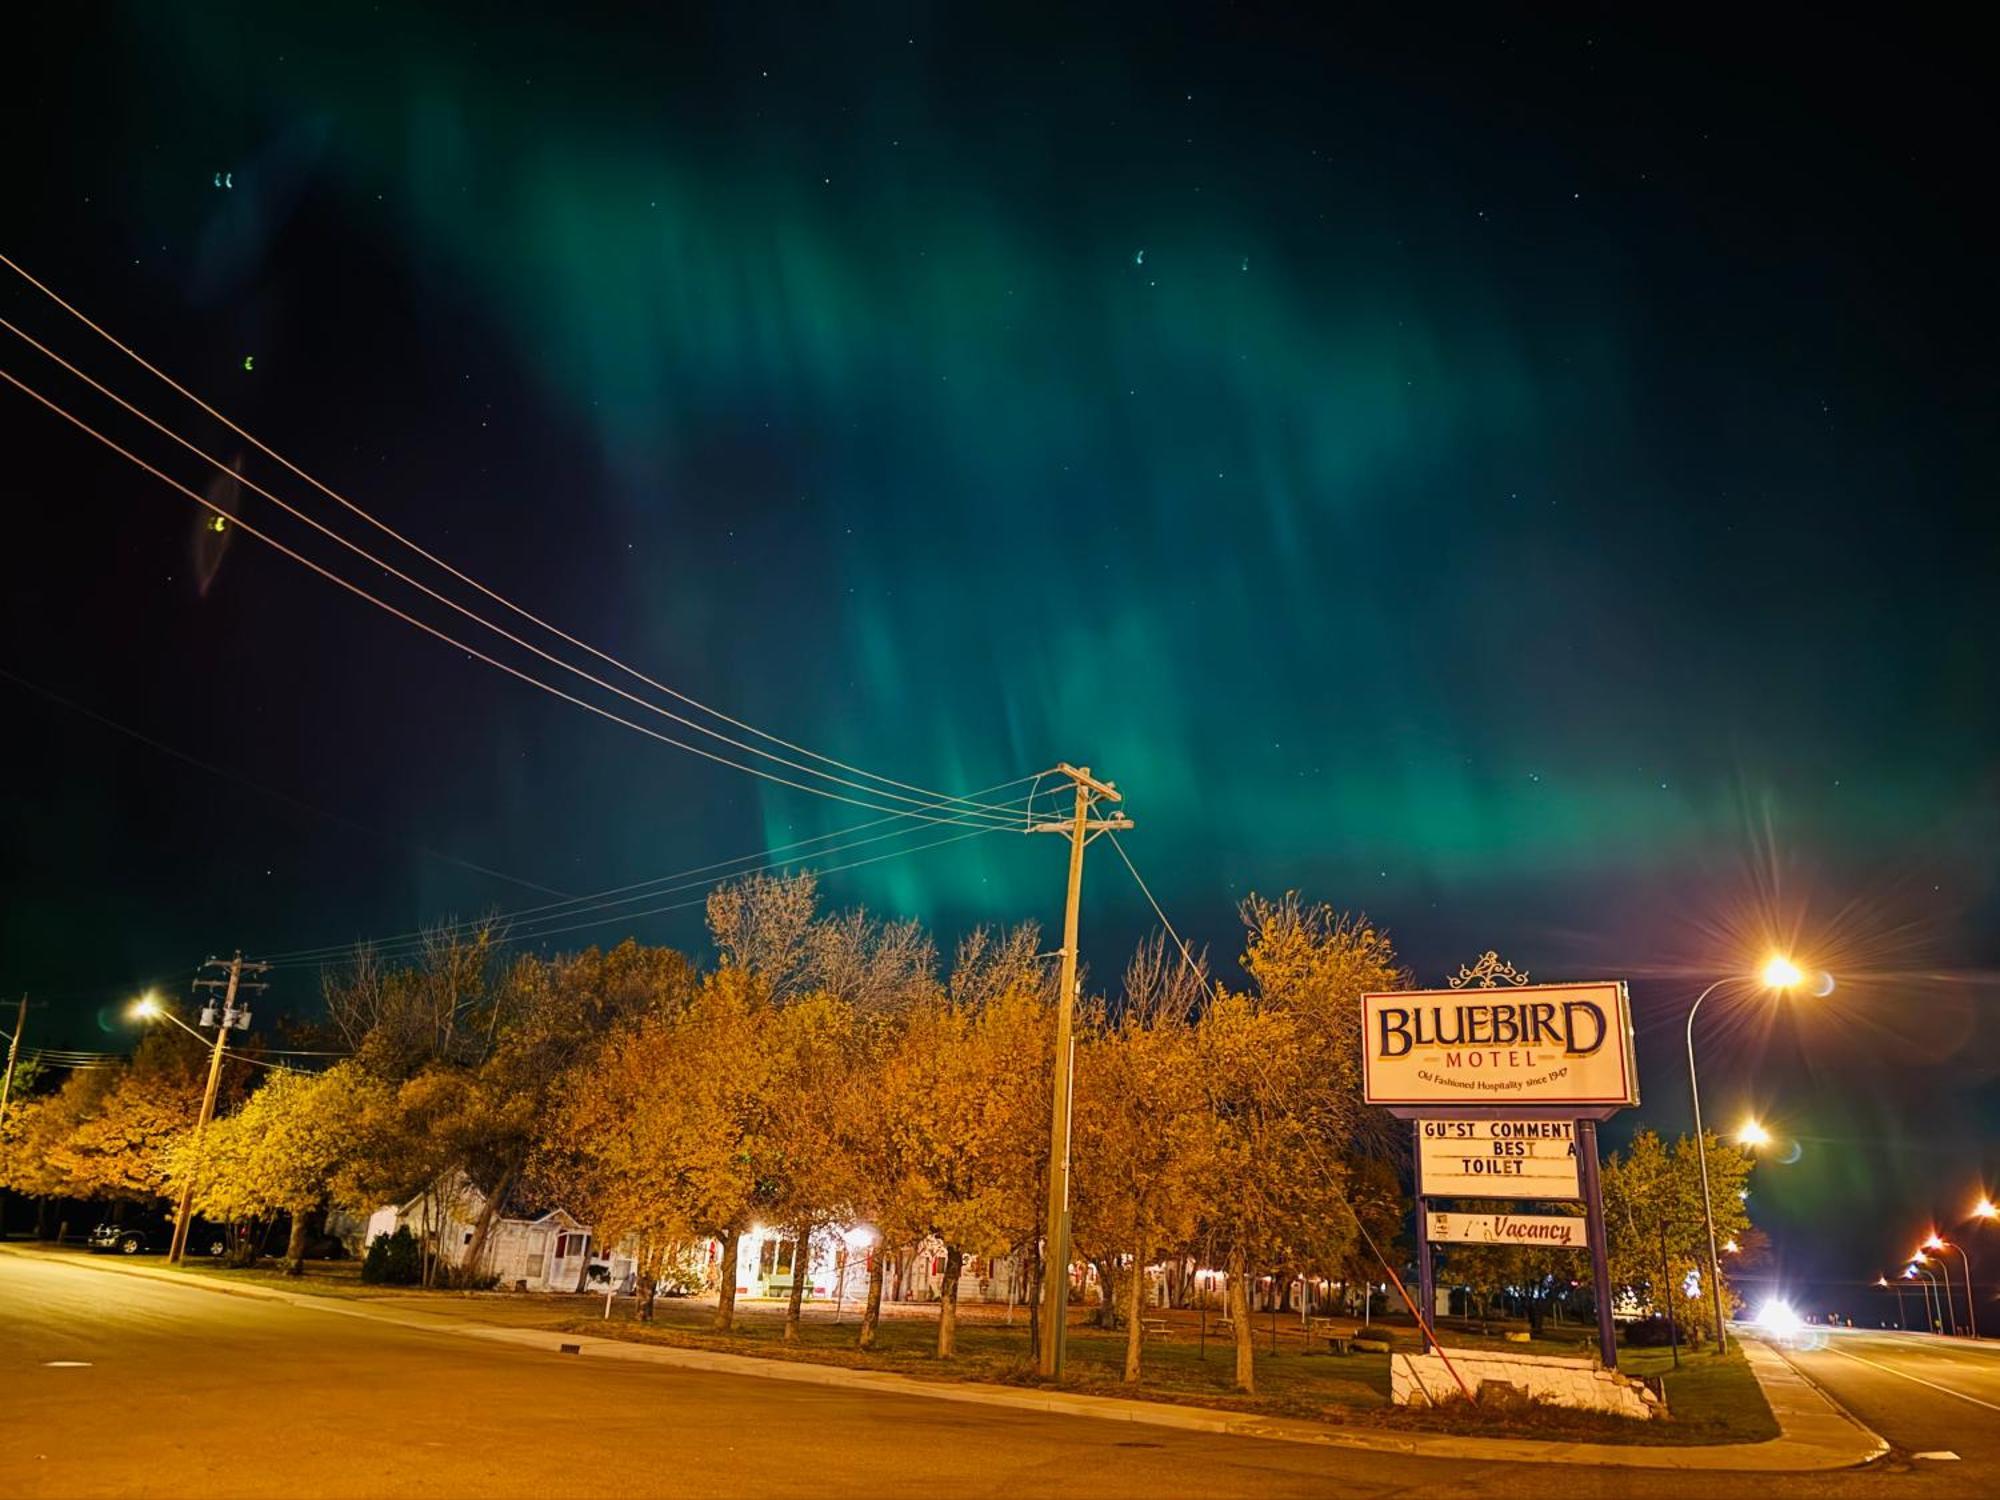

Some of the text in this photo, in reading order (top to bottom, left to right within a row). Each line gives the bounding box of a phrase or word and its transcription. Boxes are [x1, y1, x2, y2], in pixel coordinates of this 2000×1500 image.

[1378, 1001, 1607, 1057] BLUEBIRD
[1446, 1051, 1537, 1068] MOTEL
[1418, 1070, 1433, 1082] Old
[1434, 1075, 1475, 1090] Fashioned
[1477, 1081, 1523, 1092] Hospitality
[1526, 1077, 1547, 1087] since
[1425, 1123, 1572, 1138] GUST COMMENT
[1494, 1142, 1577, 1157] BEST A
[1462, 1159, 1523, 1174] TOILET
[1494, 1216, 1572, 1244] Vacancy
